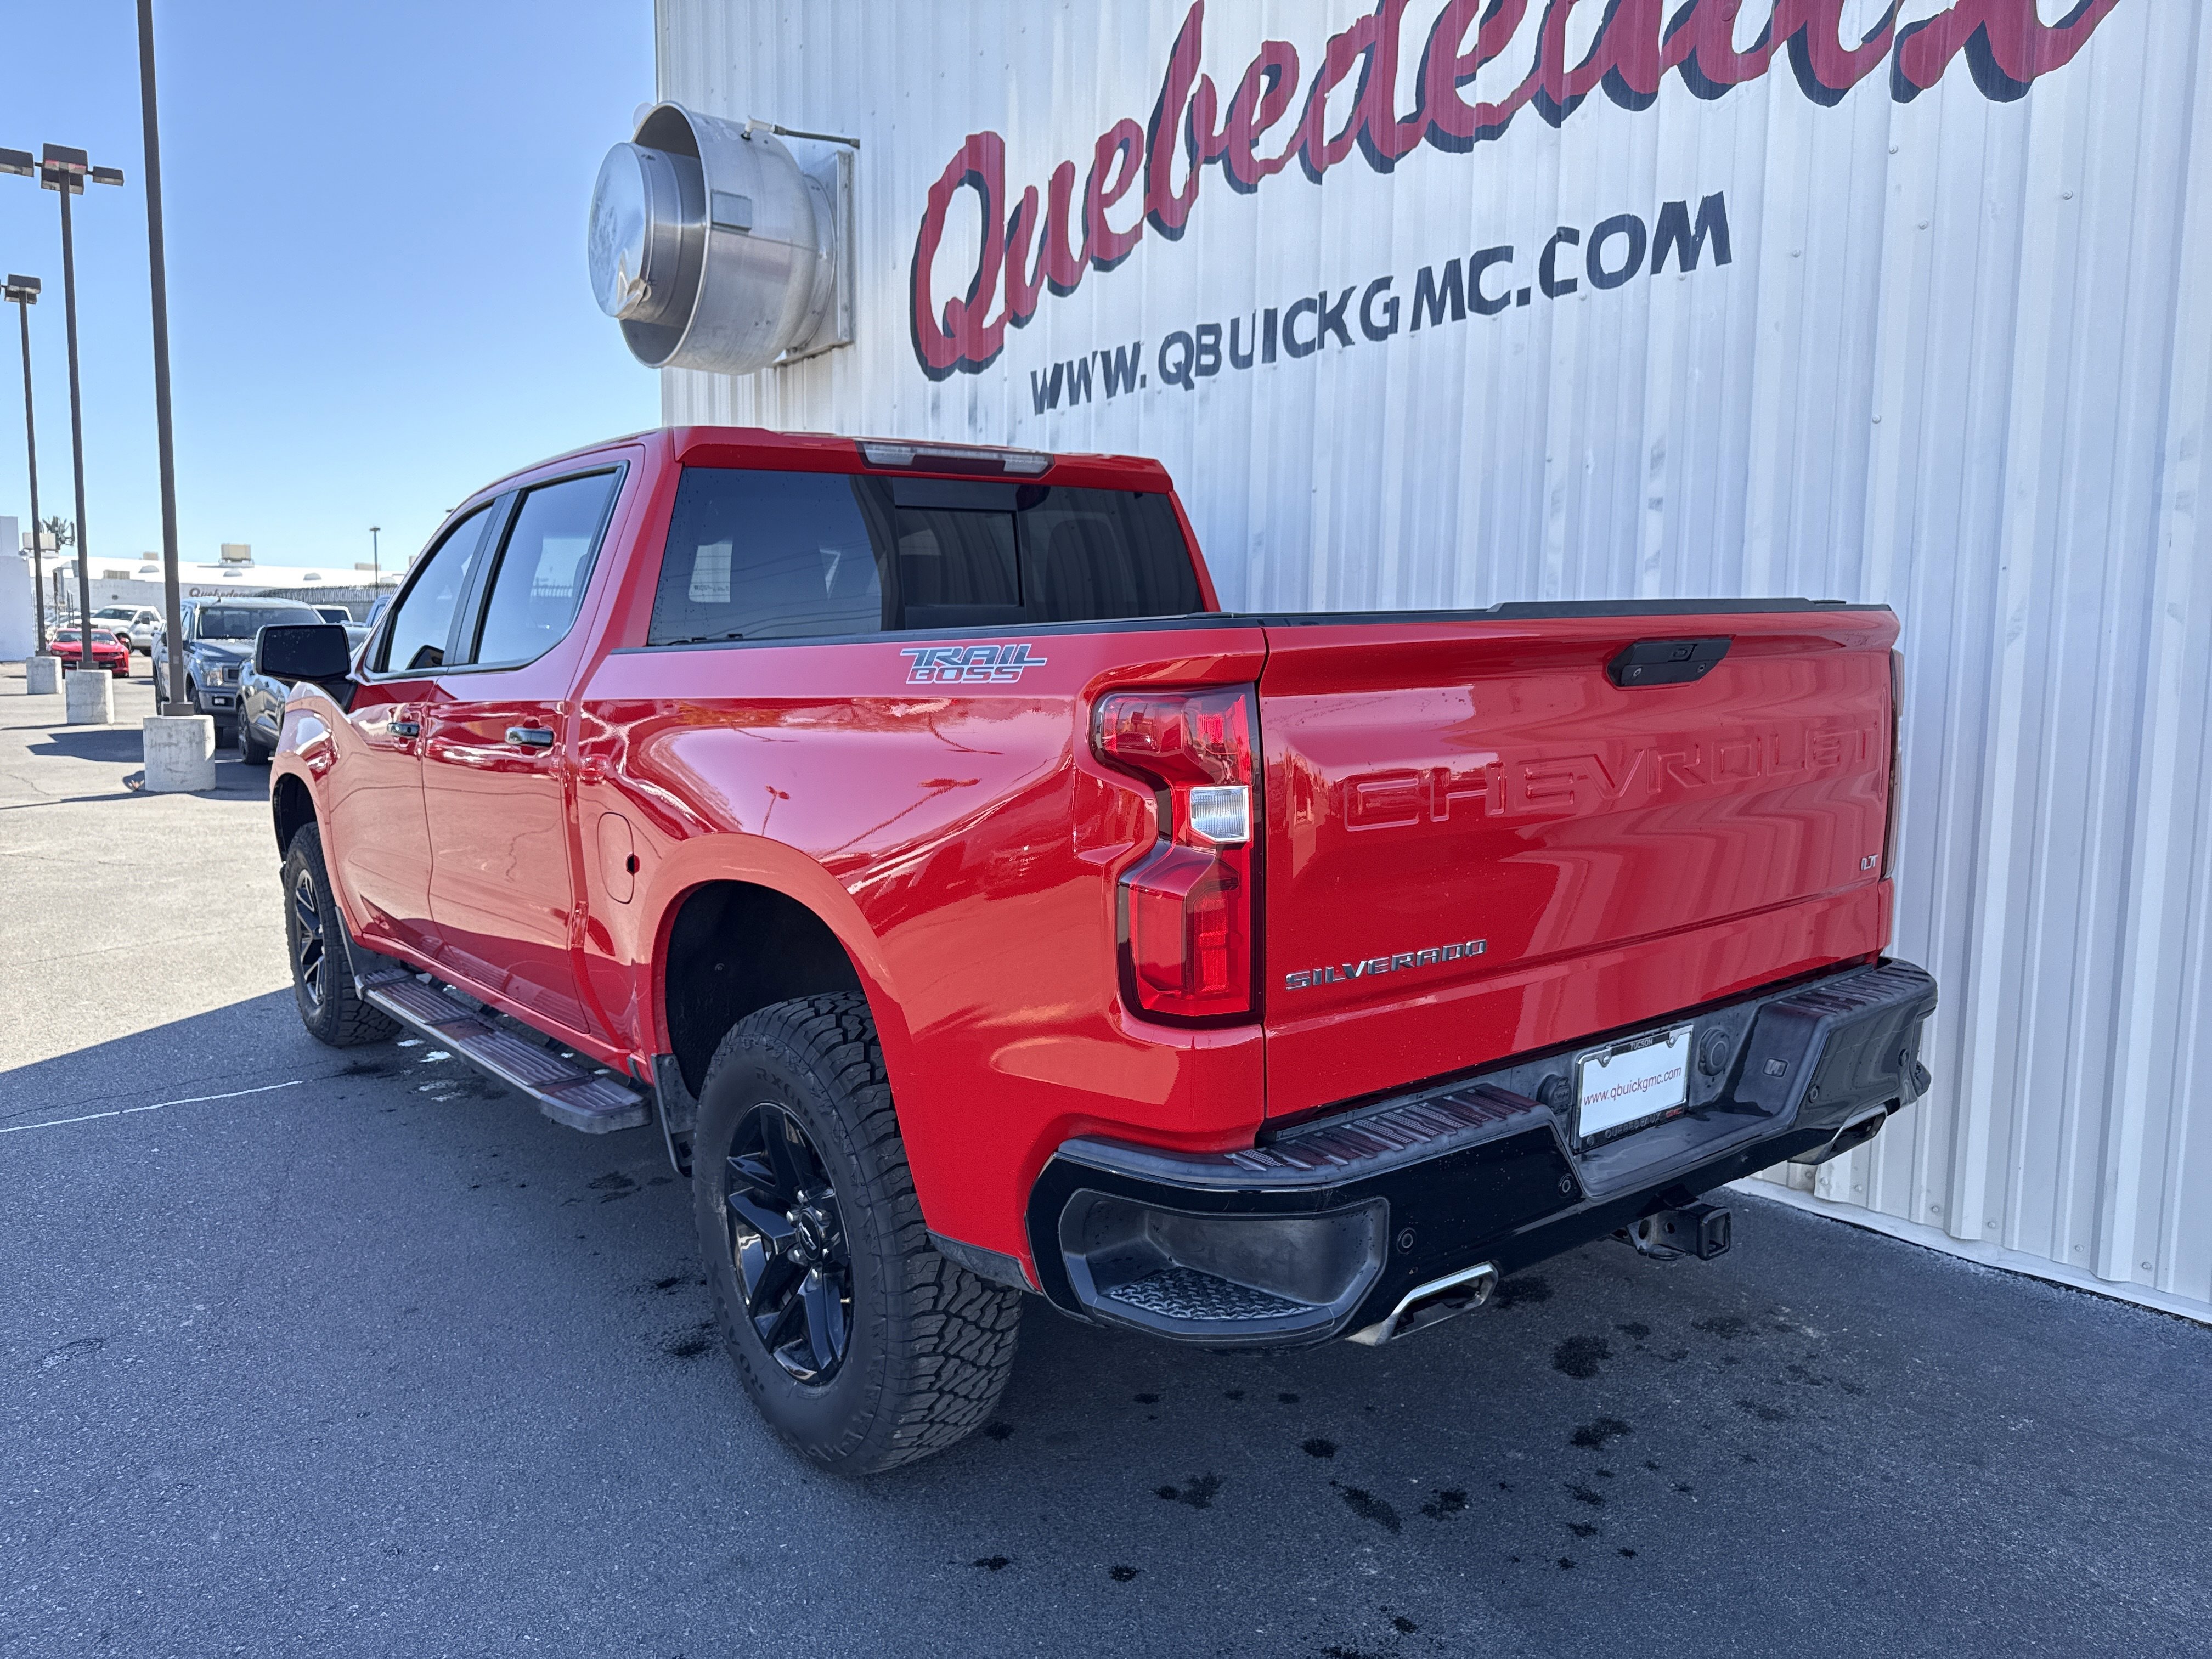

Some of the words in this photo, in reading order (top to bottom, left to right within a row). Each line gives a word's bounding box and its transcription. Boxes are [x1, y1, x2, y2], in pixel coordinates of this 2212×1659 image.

[1030, 190, 1732, 416] WWW.QBUICKGMC.COM
[900, 644, 1048, 667] TRAIL
[906, 665, 1024, 684] BOSS
[1342, 720, 1878, 832] CHEVROLET
[1860, 854, 1879, 871] LT
[1285, 938, 1487, 991] SILVERADO
[1630, 1038, 1653, 1051] TUCSON
[1583, 1066, 1681, 1106] www.qbuickgmc.com
